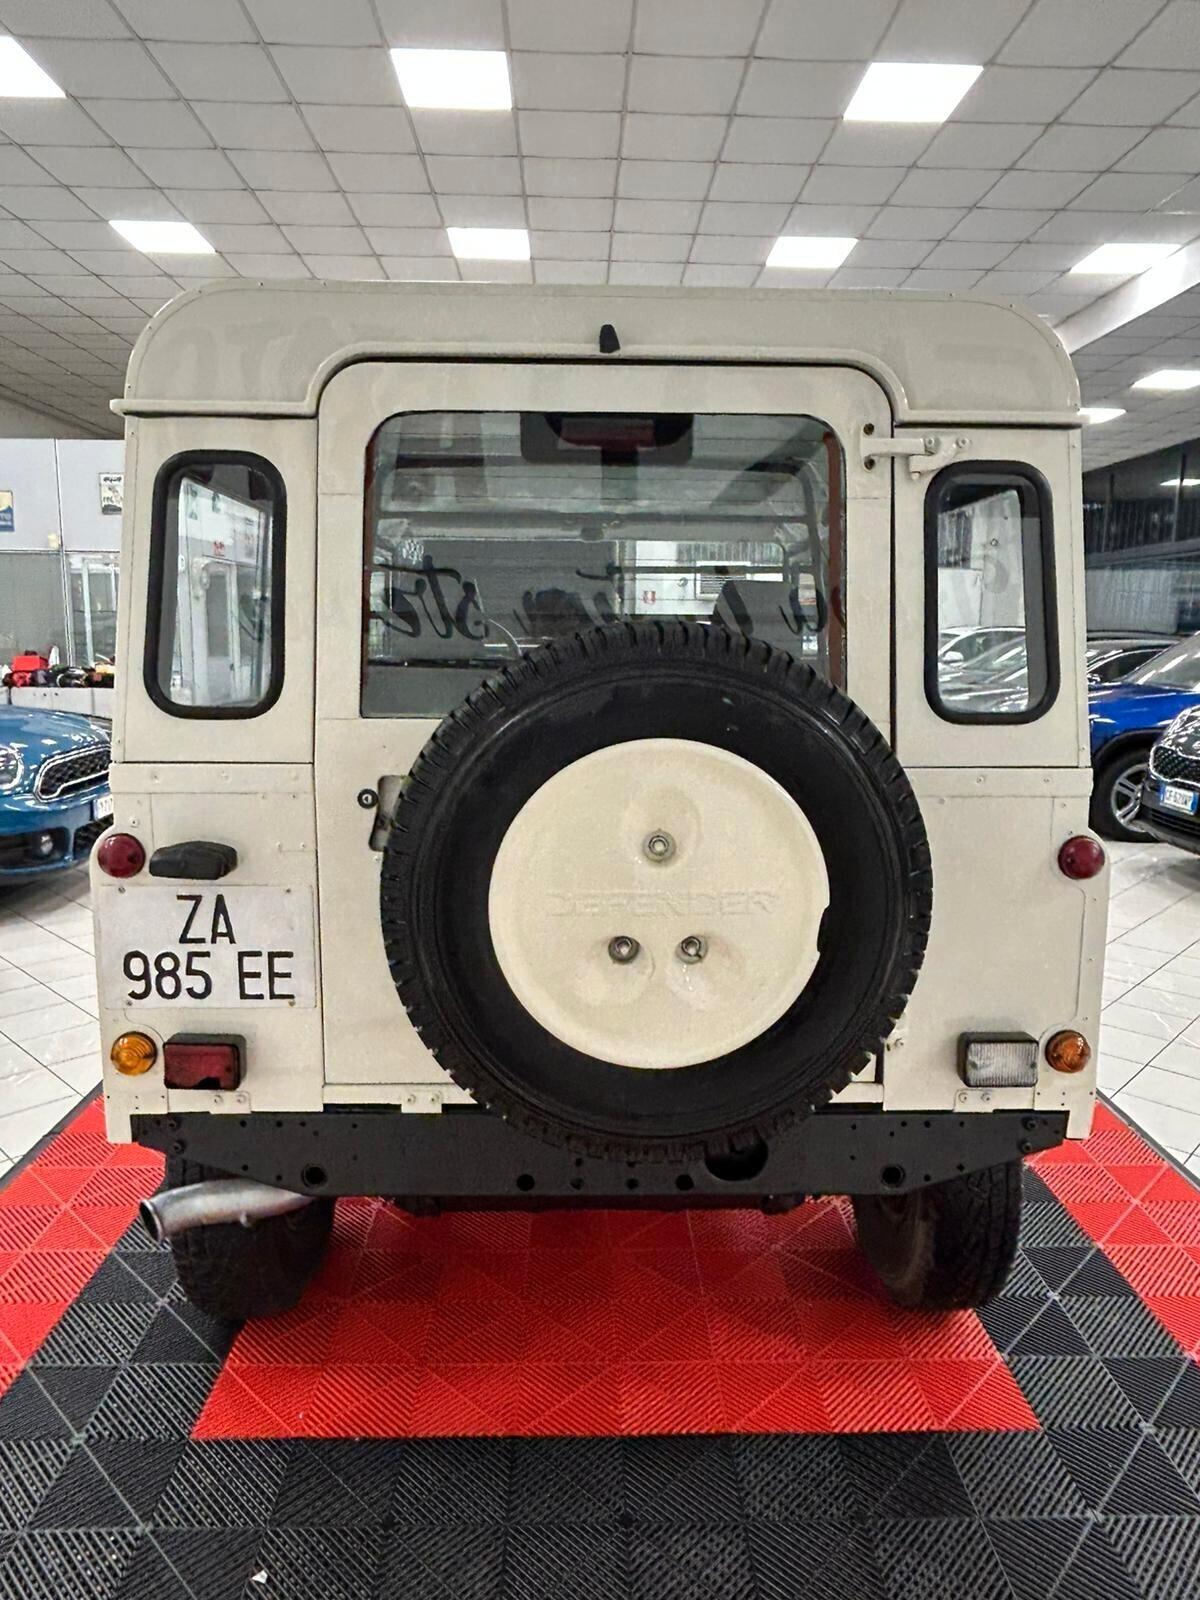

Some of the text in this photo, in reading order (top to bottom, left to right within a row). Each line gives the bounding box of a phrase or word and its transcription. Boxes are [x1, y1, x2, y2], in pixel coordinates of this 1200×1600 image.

[176, 893, 237, 944] ZA
[546, 891, 779, 918] DEFENDER
[123, 950, 296, 1000] 985 EE
